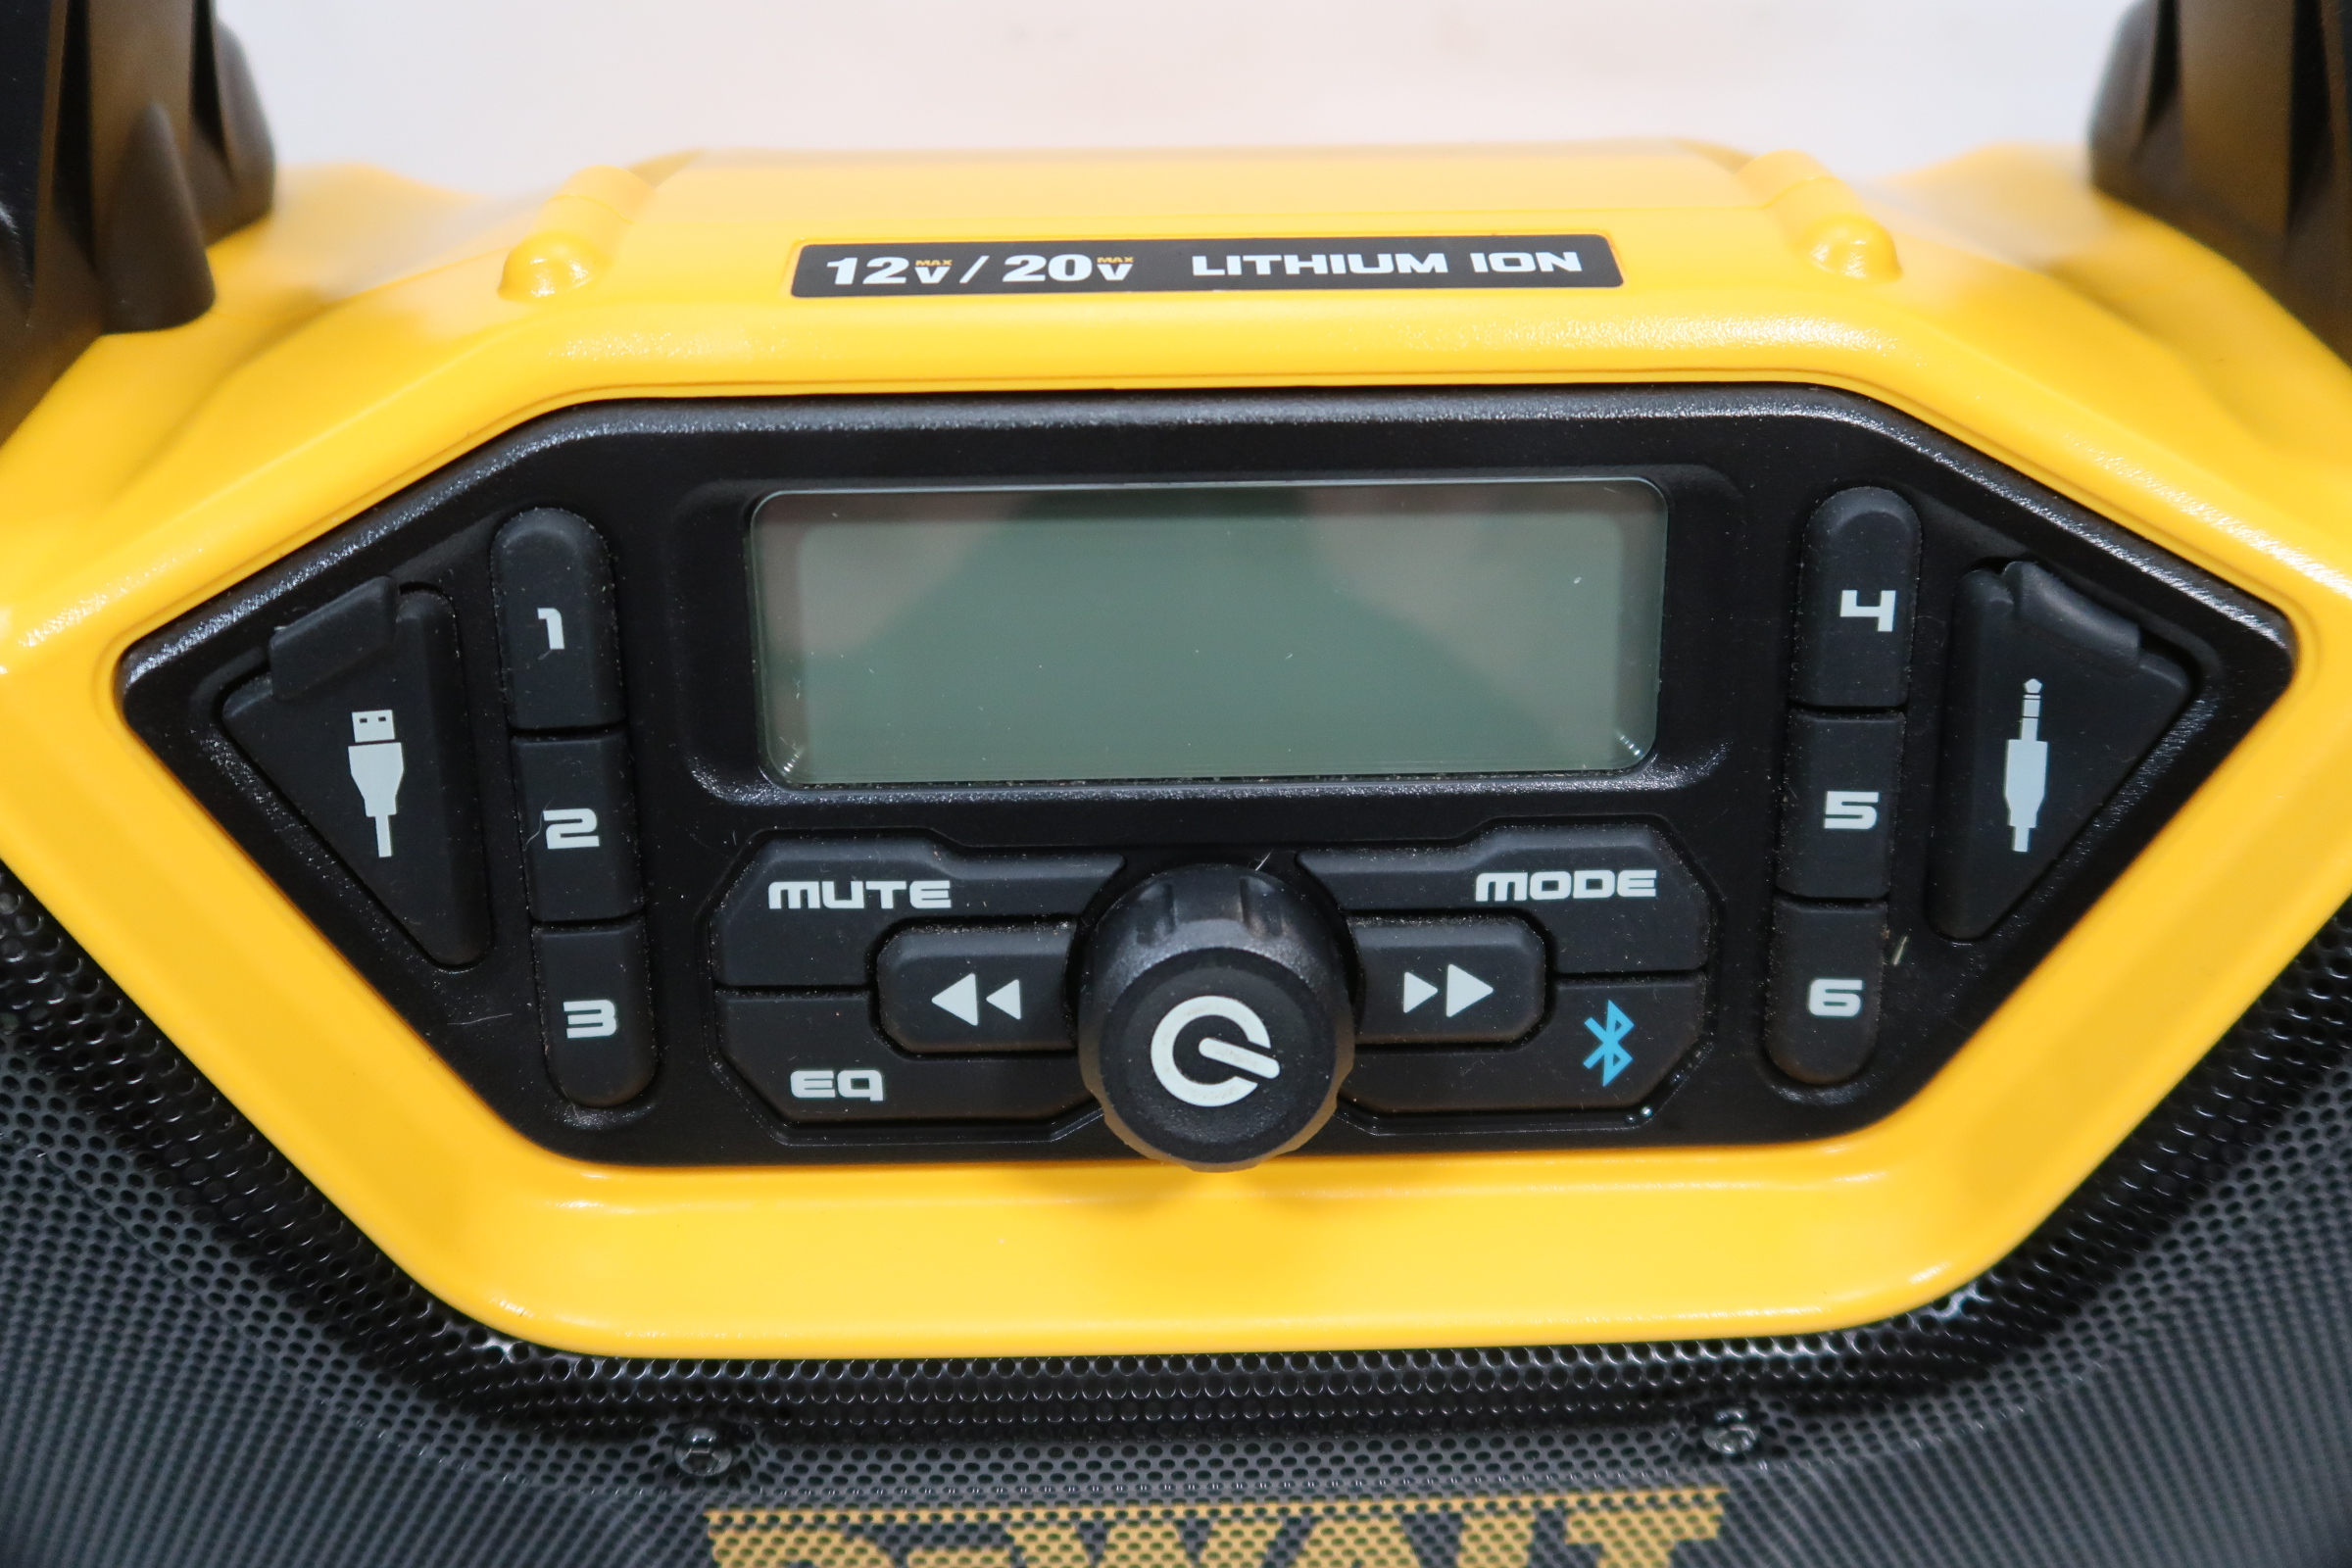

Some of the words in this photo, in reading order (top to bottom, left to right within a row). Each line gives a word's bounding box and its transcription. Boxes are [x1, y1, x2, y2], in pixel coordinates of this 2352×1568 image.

[1191, 253, 1449, 276] LITHIUM
[1470, 251, 1583, 273] ION
[537, 608, 564, 650] 1
[1839, 589, 1896, 632] 4
[542, 808, 600, 850] 2
[1824, 790, 1880, 830] 5
[767, 879, 952, 909] MUTE
[1475, 869, 1657, 902] MODE
[1808, 978, 1863, 1017] 6
[563, 999, 617, 1039] 3
[790, 1069, 884, 1102] EQ
